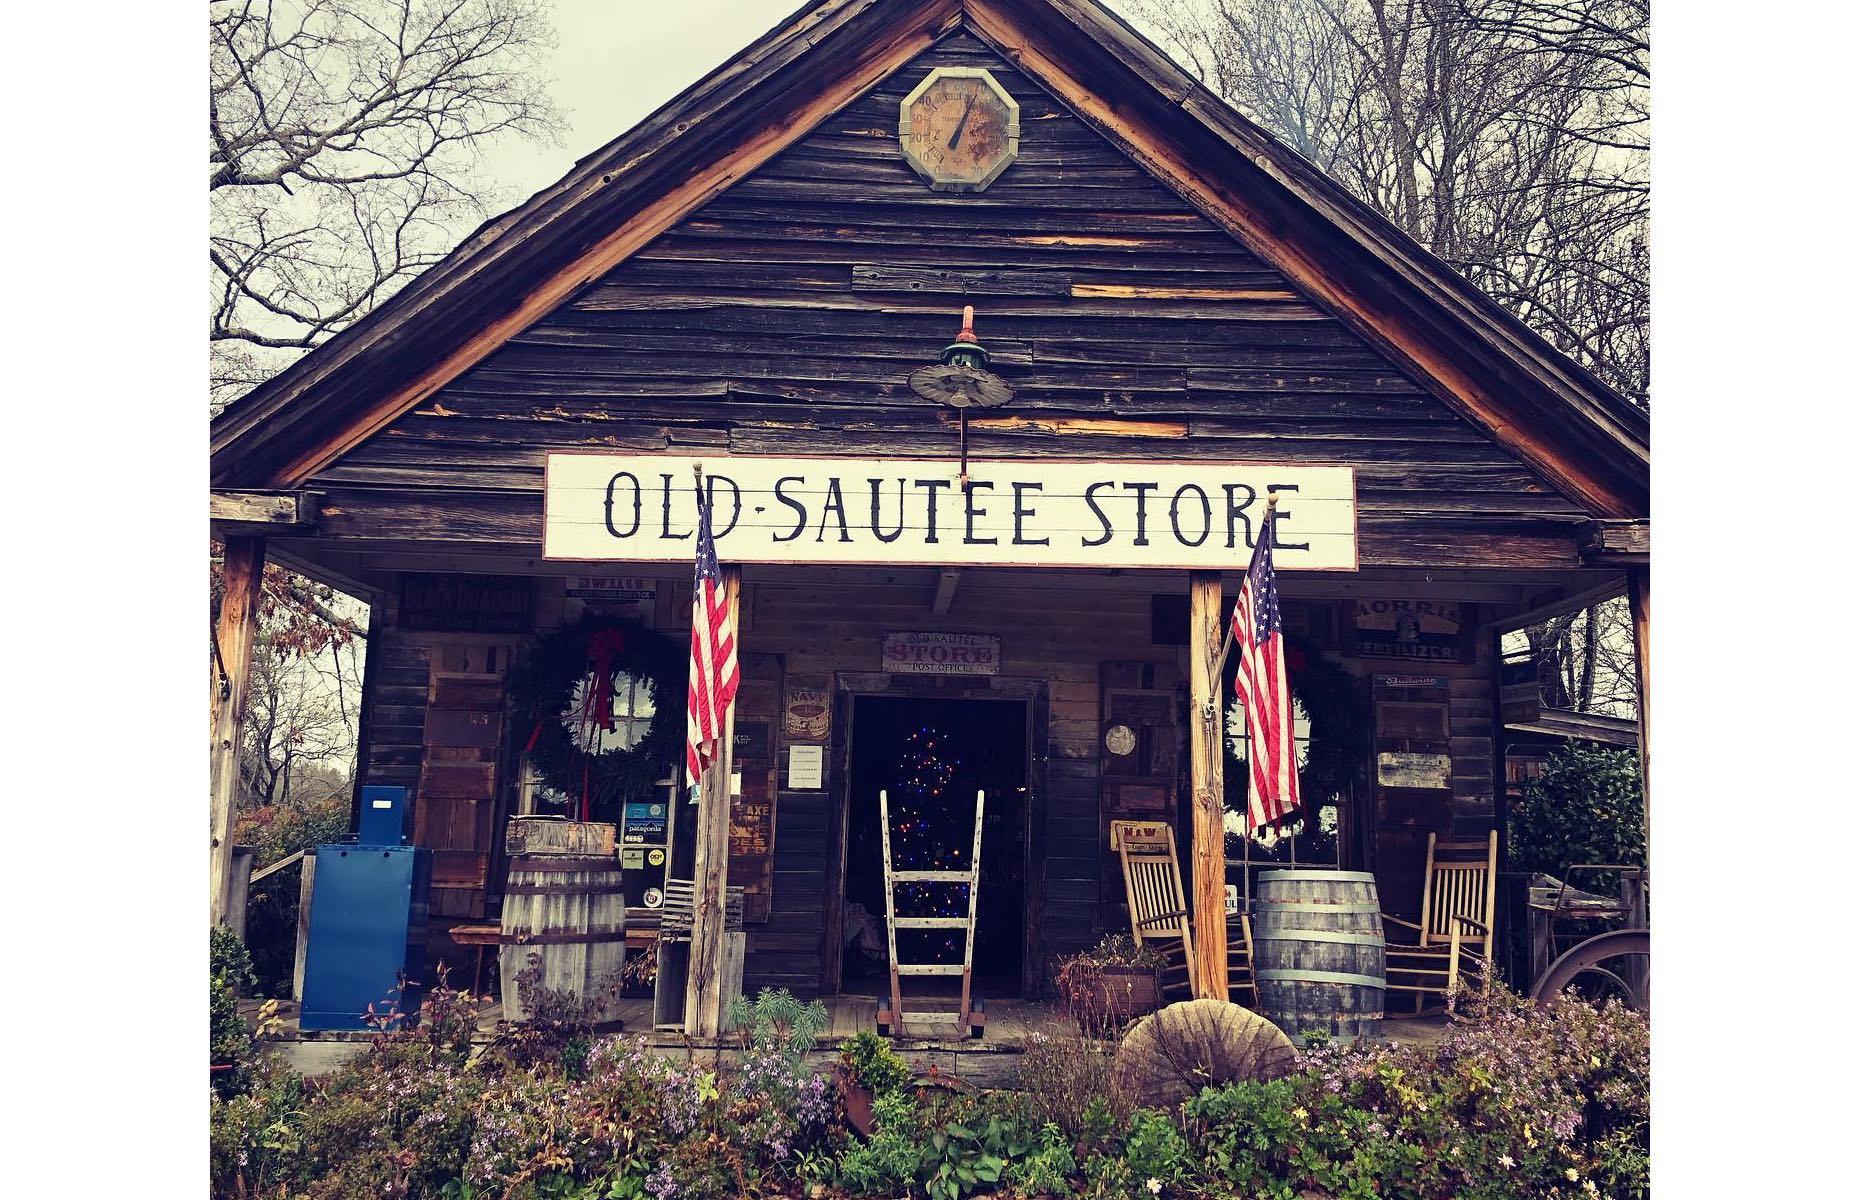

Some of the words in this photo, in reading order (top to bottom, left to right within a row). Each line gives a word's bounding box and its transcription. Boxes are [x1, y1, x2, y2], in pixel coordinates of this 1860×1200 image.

[1082, 480, 1310, 551] STORE
[907, 634, 930, 644] OLD
[934, 634, 976, 646] SAUTEE
[888, 644, 992, 664] STORE
[912, 662, 934, 671] POST
[937, 663, 968, 673] OFFICE
[746, 805, 769, 816] AXE
